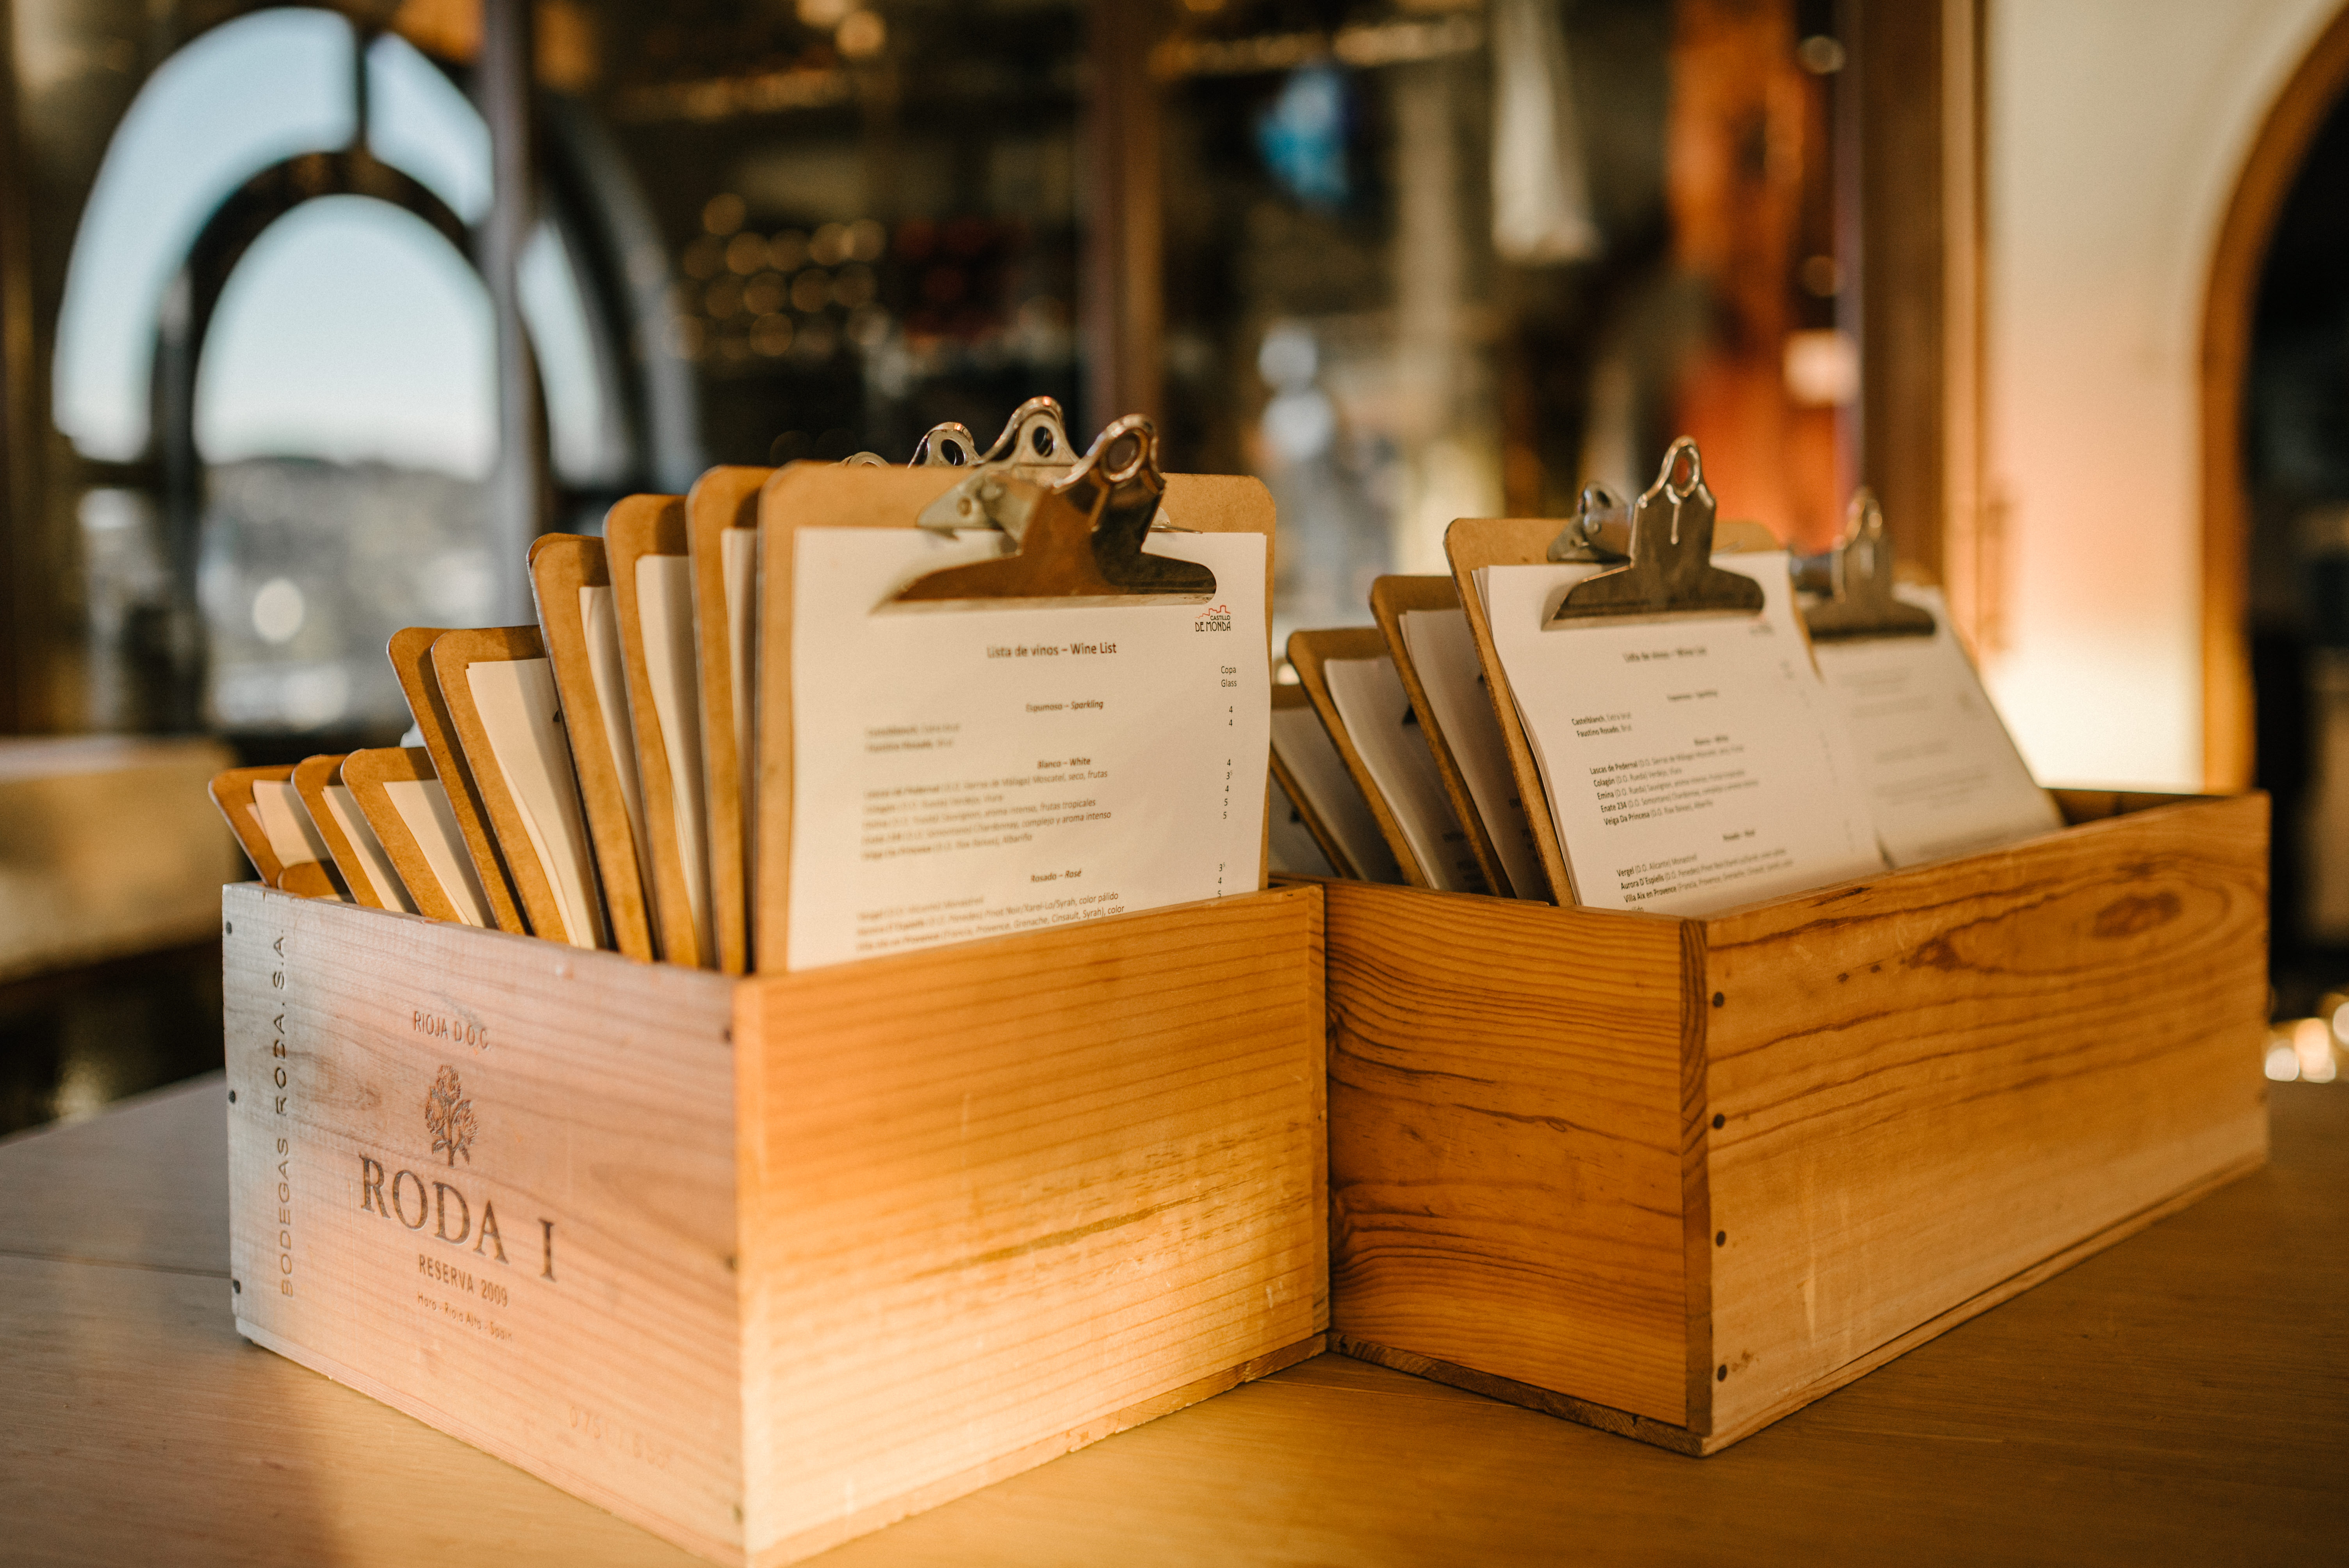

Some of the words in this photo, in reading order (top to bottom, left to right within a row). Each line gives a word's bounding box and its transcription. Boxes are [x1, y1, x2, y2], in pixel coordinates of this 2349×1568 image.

[1195, 622, 1205, 631] DE
[1206, 621, 1231, 631] MONDA
[987, 645, 1011, 658] Lista
[1015, 644, 1027, 657] de
[1031, 644, 1058, 656] vinos
[1070, 643, 1096, 654] Wine
[1100, 642, 1116, 654] List
[1221, 666, 1236, 675] Copa
[1221, 679, 1237, 688] Glass
[1026, 703, 1062, 712] Espumoso
[1071, 700, 1103, 710] Sparkling
[1576, 729, 1600, 738] Faustino
[1037, 760, 1061, 769] Blanco
[1069, 757, 1091, 766] White
[1590, 766, 1607, 775] Lascas
[1615, 761, 1638, 771] Pedernal
[1088, 770, 1108, 780] frutas
[1597, 791, 1614, 800] Emina
[1040, 802, 1060, 811] frutas
[1062, 798, 1096, 810] tropicales
[1600, 804, 1616, 813] Enate
[1617, 801, 1627, 810] 234
[1022, 817, 1054, 829] complejo
[1056, 818, 1060, 826] y
[1062, 814, 1084, 824] aroma
[1086, 811, 1111, 821] intenso
[1604, 816, 1620, 827] Veiga
[1620, 814, 1628, 823] Da
[1628, 811, 1650, 821] Princesa
[1030, 872, 1057, 883] Rosado
[1065, 868, 1082, 879] Rosé
[1616, 865, 1634, 877] Vergel
[1621, 880, 1639, 891] Aurora
[1079, 896, 1097, 905] color
[1098, 892, 1118, 903] pálido
[1217, 890, 1222, 898] 5
[1624, 892, 1637, 903] Villa
[1637, 891, 1646, 900] Aix
[1646, 890, 1654, 899] en
[1654, 885, 1677, 897] Provence
[1052, 912, 1081, 923] Cinsault,
[1083, 906, 1106, 919] Syrah),
[1107, 905, 1125, 915] color
[273, 929, 285, 990] S.A.
[413, 1010, 448, 1040] RIOJA
[278, 1137, 294, 1297] BODEGAS
[359, 1152, 509, 1265] RODA
[538, 1217, 557, 1283] I
[419, 1253, 474, 1295] RESERVA
[481, 1279, 508, 1308] 2009
[418, 1291, 437, 1311] Haro
[445, 1302, 463, 1324] Rioja
[466, 1312, 481, 1330] Alta
[490, 1321, 512, 1343] Spain
